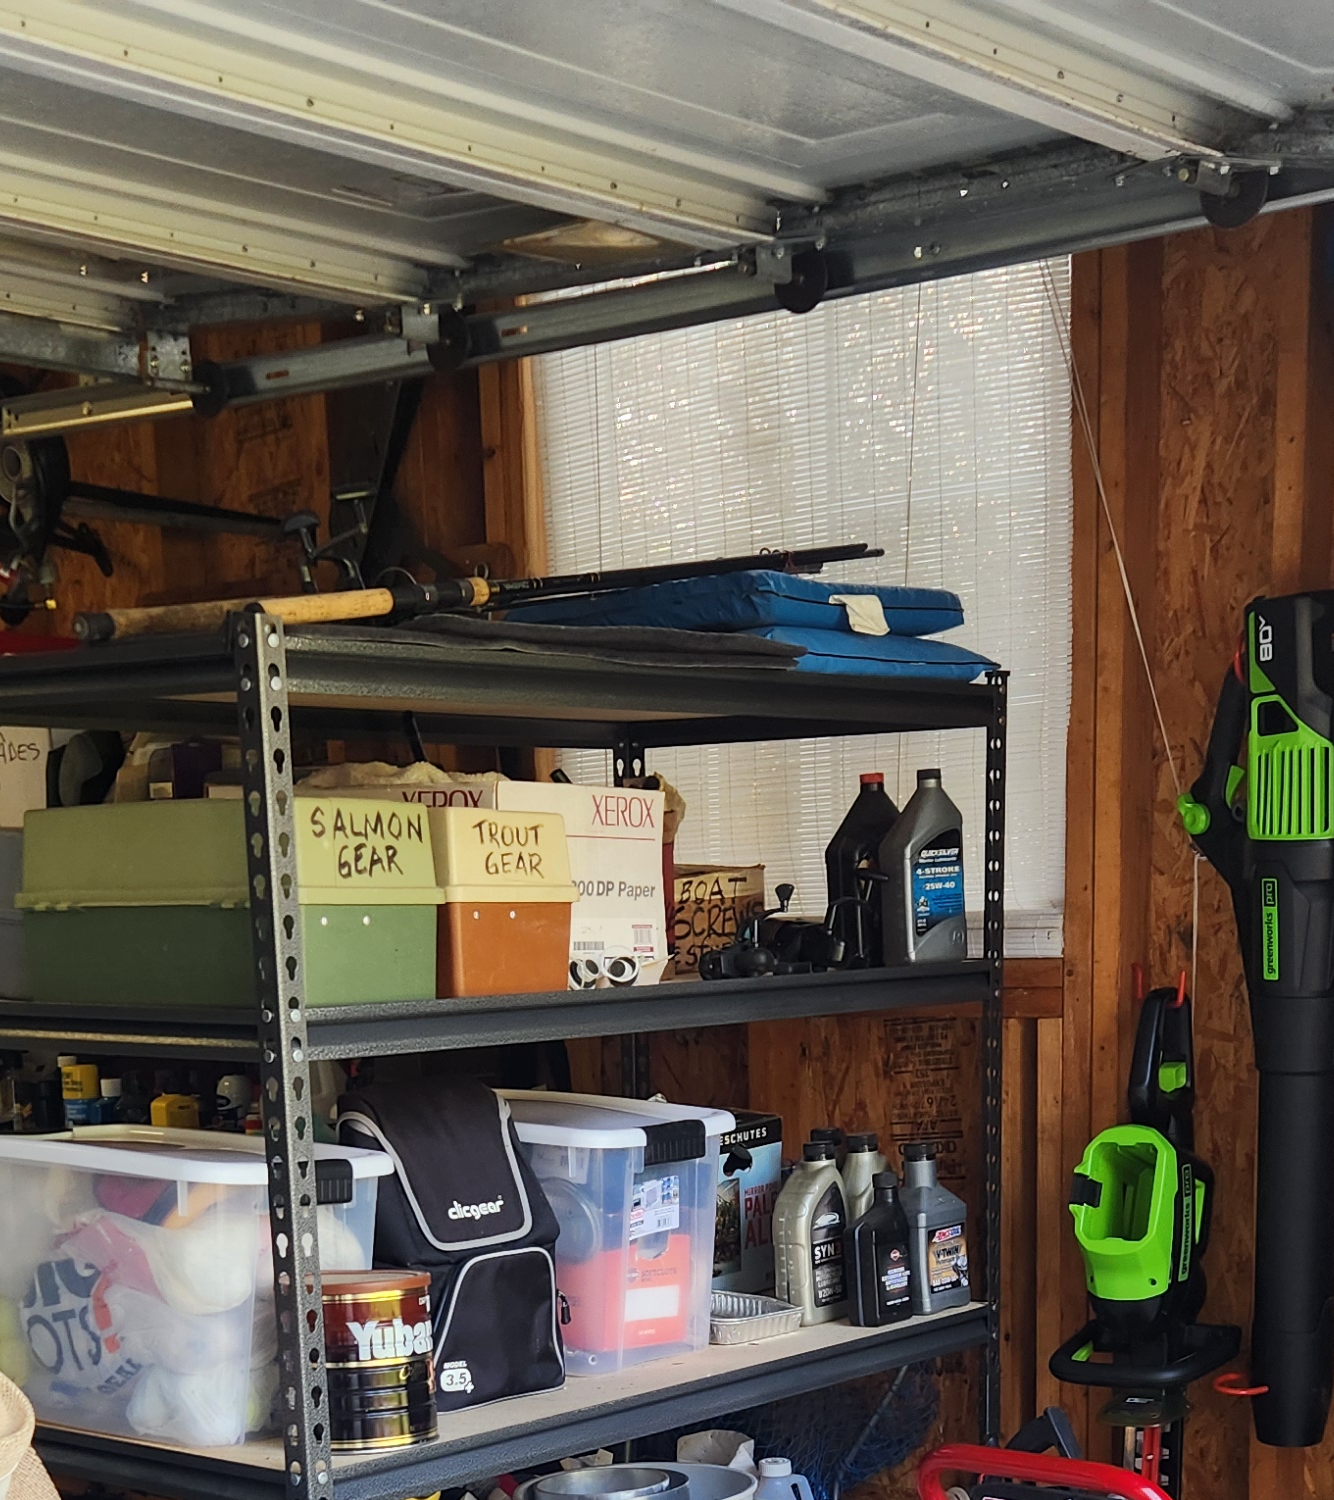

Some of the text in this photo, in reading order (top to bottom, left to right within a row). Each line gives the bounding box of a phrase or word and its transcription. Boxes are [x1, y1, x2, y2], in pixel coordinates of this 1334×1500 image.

[1259, 615, 1272, 661] 80V
[310, 806, 423, 844] SALMON
[592, 795, 655, 828] XEROX
[472, 819, 544, 848] TROUT
[338, 843, 403, 879] GEAR
[485, 851, 544, 879] GEAR
[916, 865, 960, 876] 4-STROKE
[596, 881, 614, 896] DP
[618, 883, 655, 901] Paper
[679, 877, 747, 905] BOAT
[925, 881, 955, 891] 25W-40
[1266, 883, 1275, 905] pro
[1265, 912, 1276, 975] greenworks
[448, 1199, 505, 1220] clicgear
[1180, 1201, 1192, 1276] greenworks
[443, 1360, 468, 1369] MODEL
